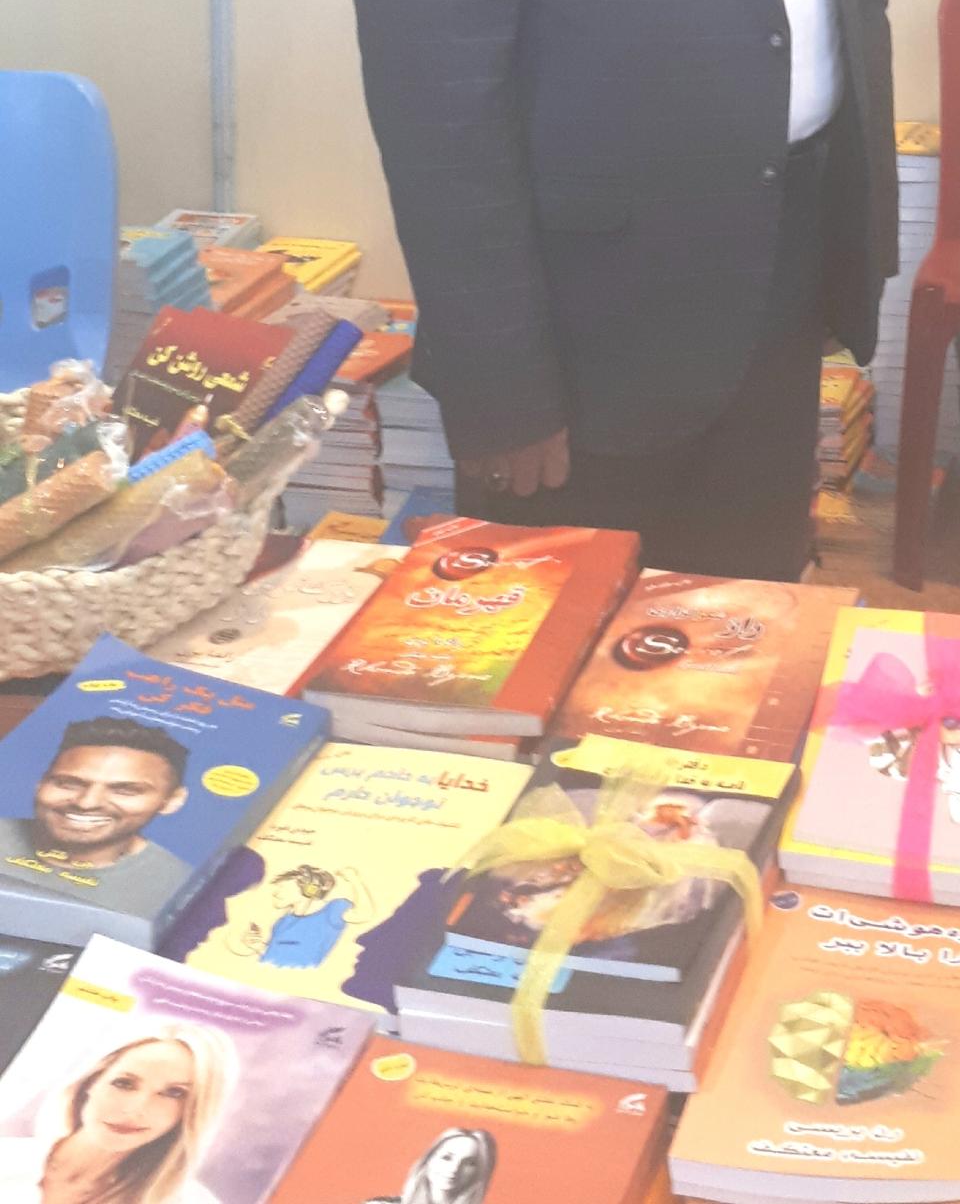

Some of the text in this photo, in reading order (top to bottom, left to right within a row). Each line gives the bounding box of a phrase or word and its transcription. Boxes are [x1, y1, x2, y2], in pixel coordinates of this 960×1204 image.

[146, 345, 178, 366] کن
[436, 770, 490, 792] خدایا
[879, 943, 928, 961] بالا
